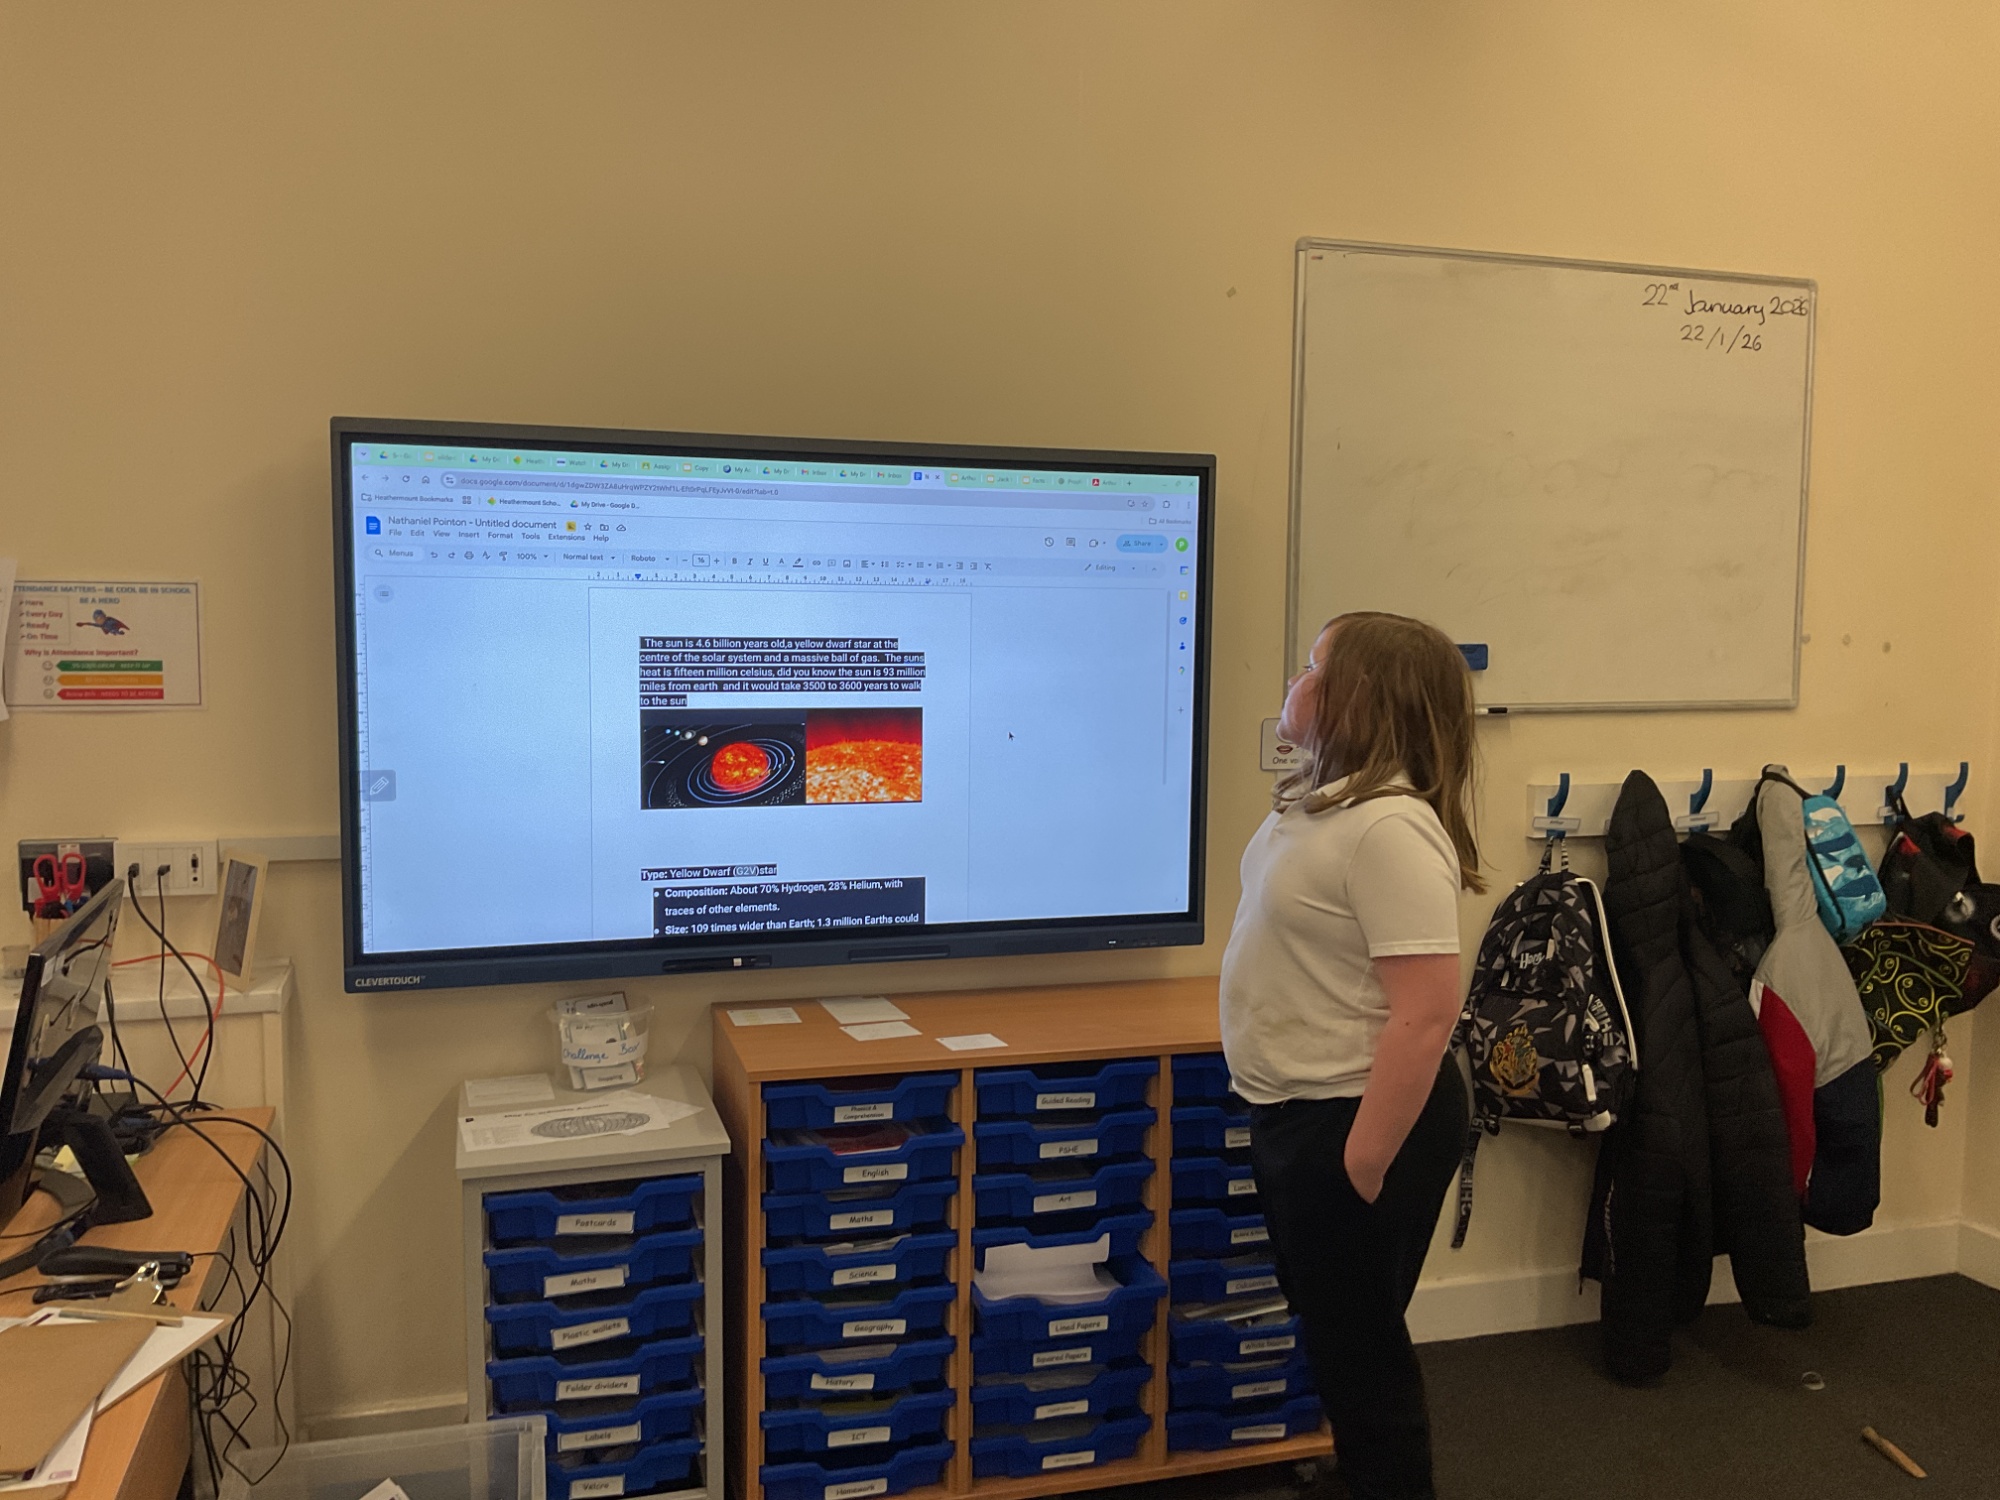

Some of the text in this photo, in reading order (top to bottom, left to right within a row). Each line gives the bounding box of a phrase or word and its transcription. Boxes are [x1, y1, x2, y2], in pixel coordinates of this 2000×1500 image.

[1684, 289, 1766, 326] January
[1680, 324, 1762, 354] 22/1/26
[581, 501, 590, 509] My
[610, 502, 629, 510] Google
[388, 516, 557, 529] Nathaniel Pointon Untitled document
[548, 533, 585, 541] Extensions
[389, 549, 414, 557] Menus
[1095, 564, 1115, 572] Editing
[645, 638, 663, 648] The
[665, 639, 683, 648] sun
[685, 638, 693, 648] is
[695, 638, 711, 648] 4.6
[713, 638, 741, 649] billion
[743, 640, 768, 650] years
[794, 639, 824, 649] yellow
[825, 639, 852, 649] dwarf
[853, 640, 871, 649] star
[873, 640, 882, 649] at
[884, 640, 898, 649] the
[640, 653, 670, 662] centre
[672, 653, 682, 662] of
[684, 653, 700, 662] the
[702, 653, 726, 662] solar
[727, 654, 761, 664] system
[764, 653, 781, 662] and
[791, 654, 829, 662] massive
[831, 653, 848, 662] ball
[849, 653, 860, 662] of
[861, 655, 880, 664] gas.
[884, 653, 901, 662] The
[640, 668, 661, 676] heat
[663, 668, 671, 676] is
[674, 667, 704, 676] fifteen
[706, 668, 738, 676] million
[740, 668, 775, 677] celsius,
[777, 668, 791, 676] did
[793, 669, 810, 678] you
[812, 668, 836, 676] know
[838, 668, 852, 676] the
[873, 668, 881, 676] is
[883, 668, 894, 676] 93
[896, 668, 926, 676] million
[640, 682, 921, 692] miles from earth and it would take 3500 to 3600 years to walk
[640, 697, 687, 706] to the sun
[641, 870, 668, 880] Type:
[670, 868, 700, 879] Yellow
[703, 867, 731, 877] Dwarf
[665, 879, 903, 899] Composition: About 70% Hydrogen, 28% Helium, with
[664, 902, 780, 917] traces of other elements.
[665, 913, 919, 935] Size: 109 times wider than Earth; 1.3 million Earths could
[355, 976, 420, 987] CLEVERTOUCH
[1059, 1146, 1079, 1154] PSHE
[862, 1169, 889, 1178] English
[575, 1218, 617, 1227] Postcards
[849, 1215, 873, 1224] Maths
[849, 1270, 878, 1279] Science
[854, 1323, 894, 1333] Geography
[1055, 1321, 1100, 1332] Lined Papers
[562, 1327, 590, 1340] Plastic
[565, 1381, 628, 1393] Folder dividers
[826, 1378, 855, 1387] History
[851, 1433, 867, 1441] ICT
